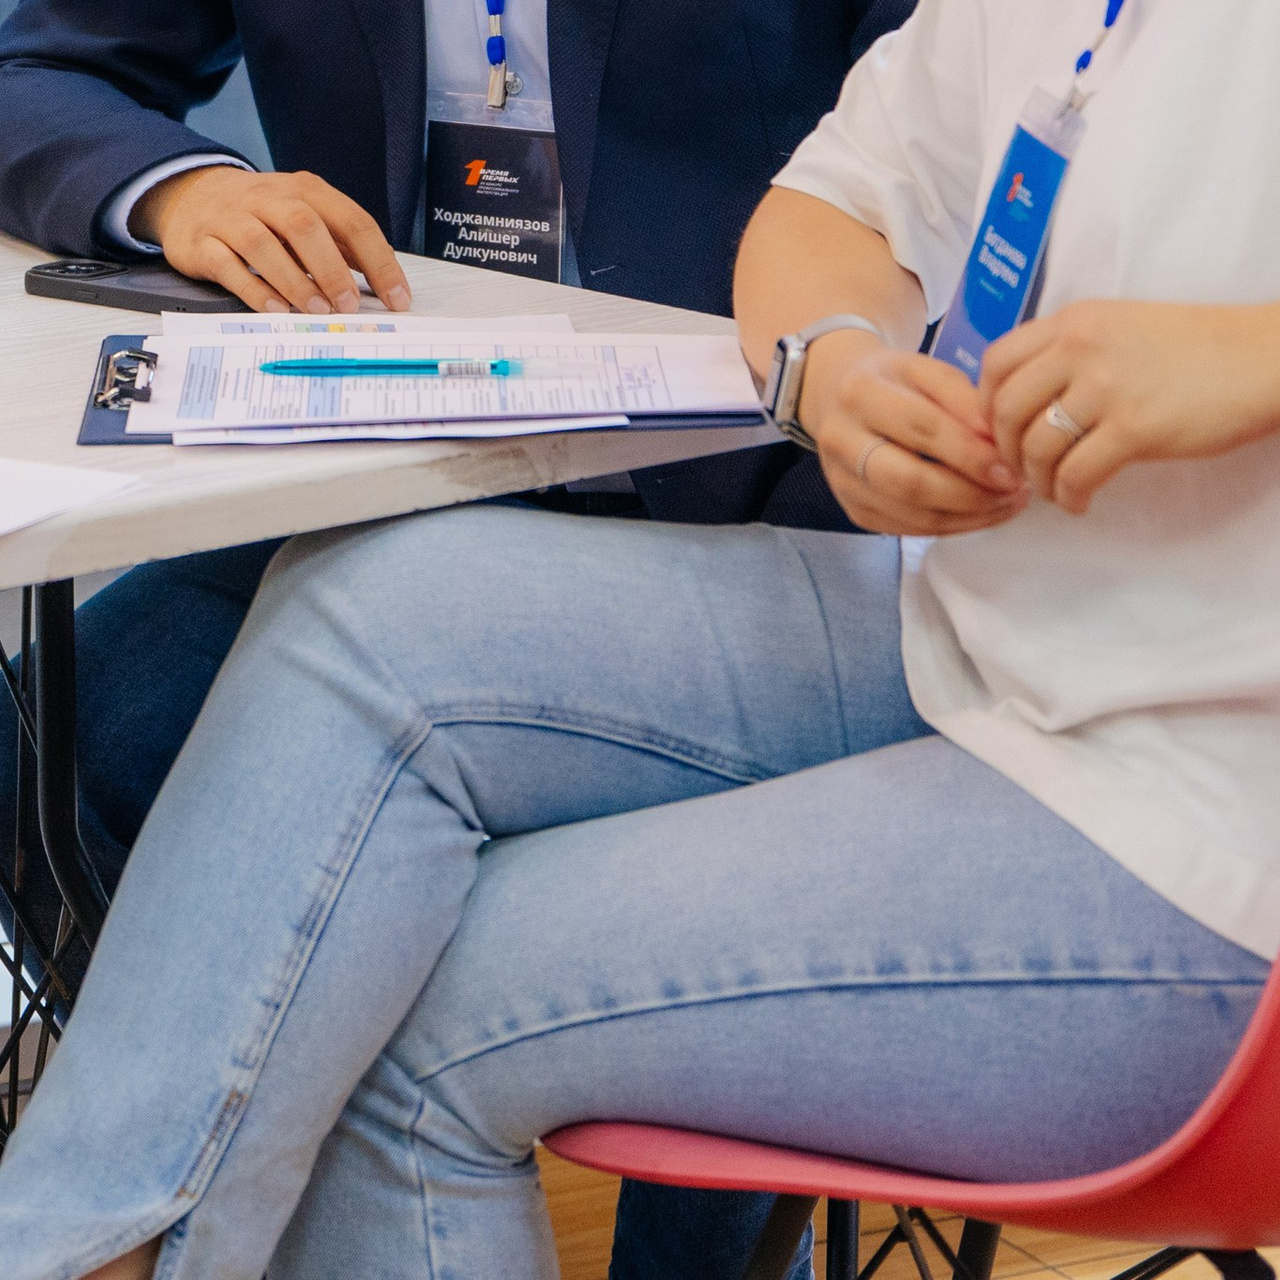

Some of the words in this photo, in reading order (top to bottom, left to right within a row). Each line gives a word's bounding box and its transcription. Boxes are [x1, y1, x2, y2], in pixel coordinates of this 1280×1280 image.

[482, 174, 520, 183] ПЕРВЫХ
[434, 207, 550, 232] Ходжамниязов
[458, 227, 520, 248] Алишер
[443, 242, 537, 264] Дулкунович
